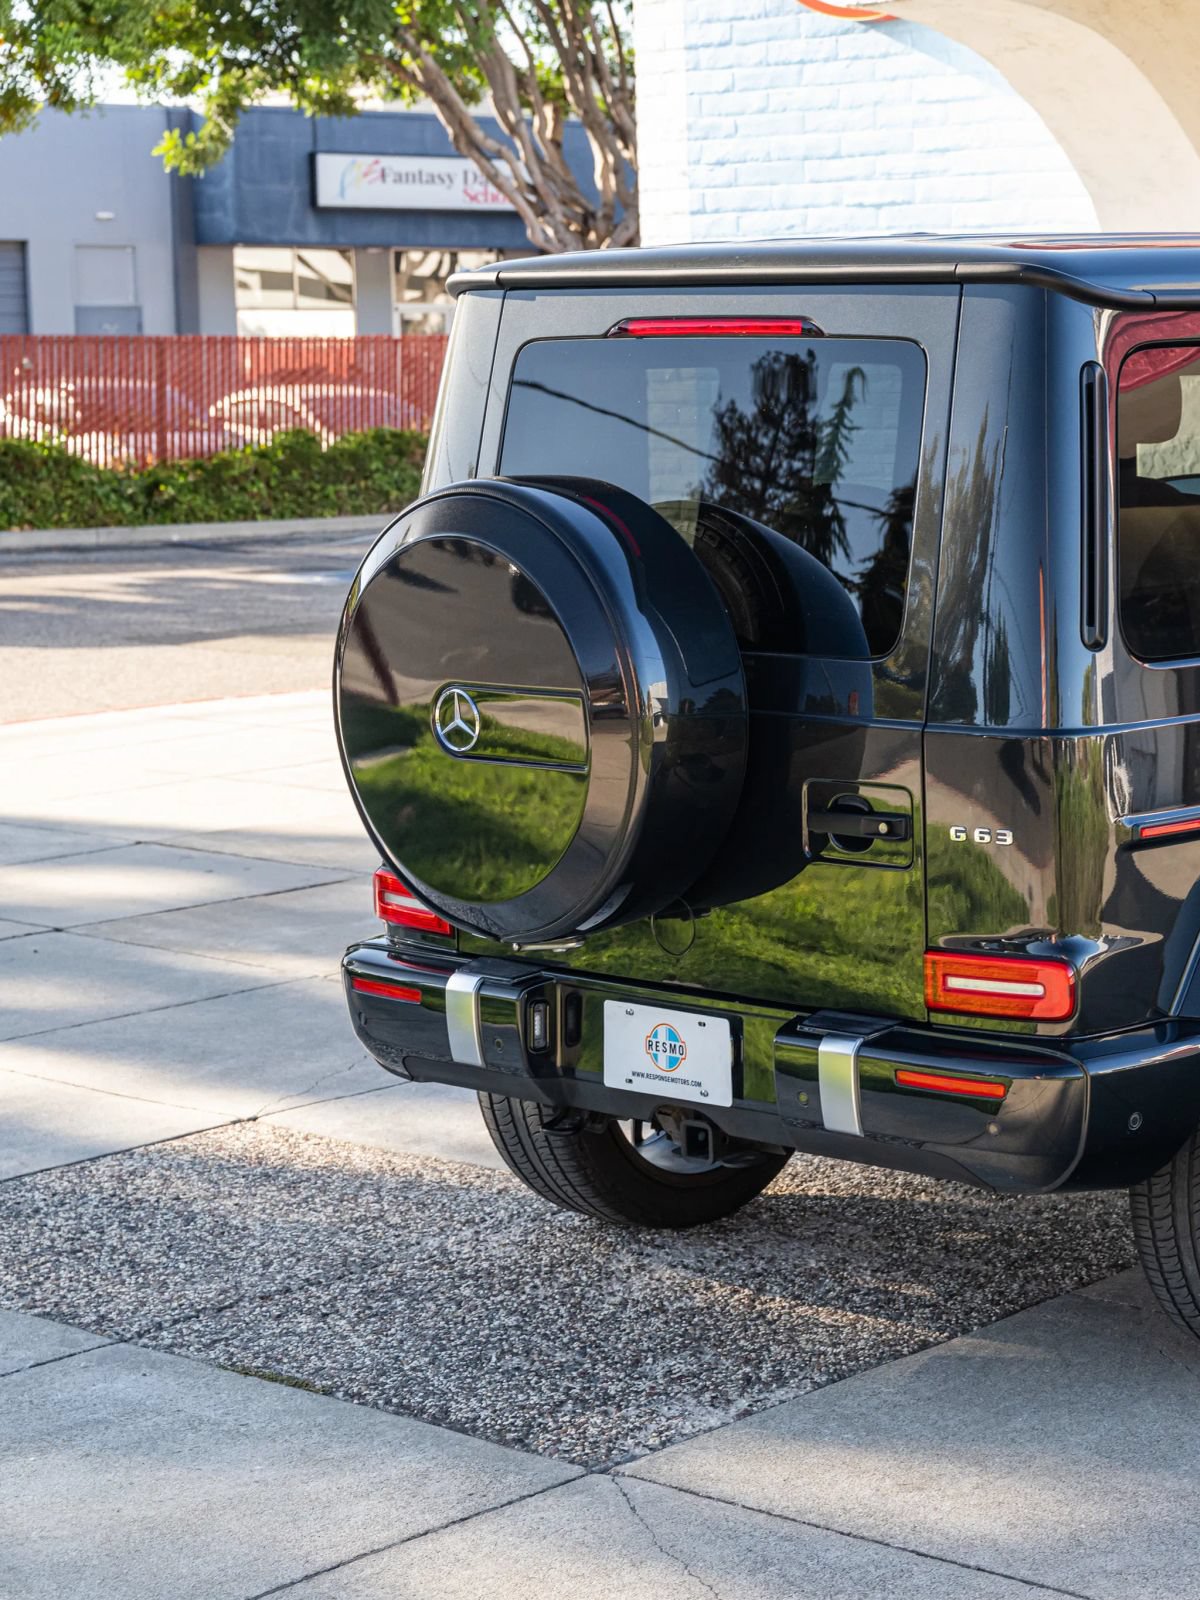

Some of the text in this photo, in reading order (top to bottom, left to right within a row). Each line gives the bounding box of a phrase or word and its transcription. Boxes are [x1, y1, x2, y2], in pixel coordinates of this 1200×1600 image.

[381, 167, 457, 189] Fantasy
[949, 826, 1014, 846] G 63
[647, 1040, 685, 1056] RESMO
[631, 1070, 703, 1088] WWW.RESPONSEMOTORS.COM
